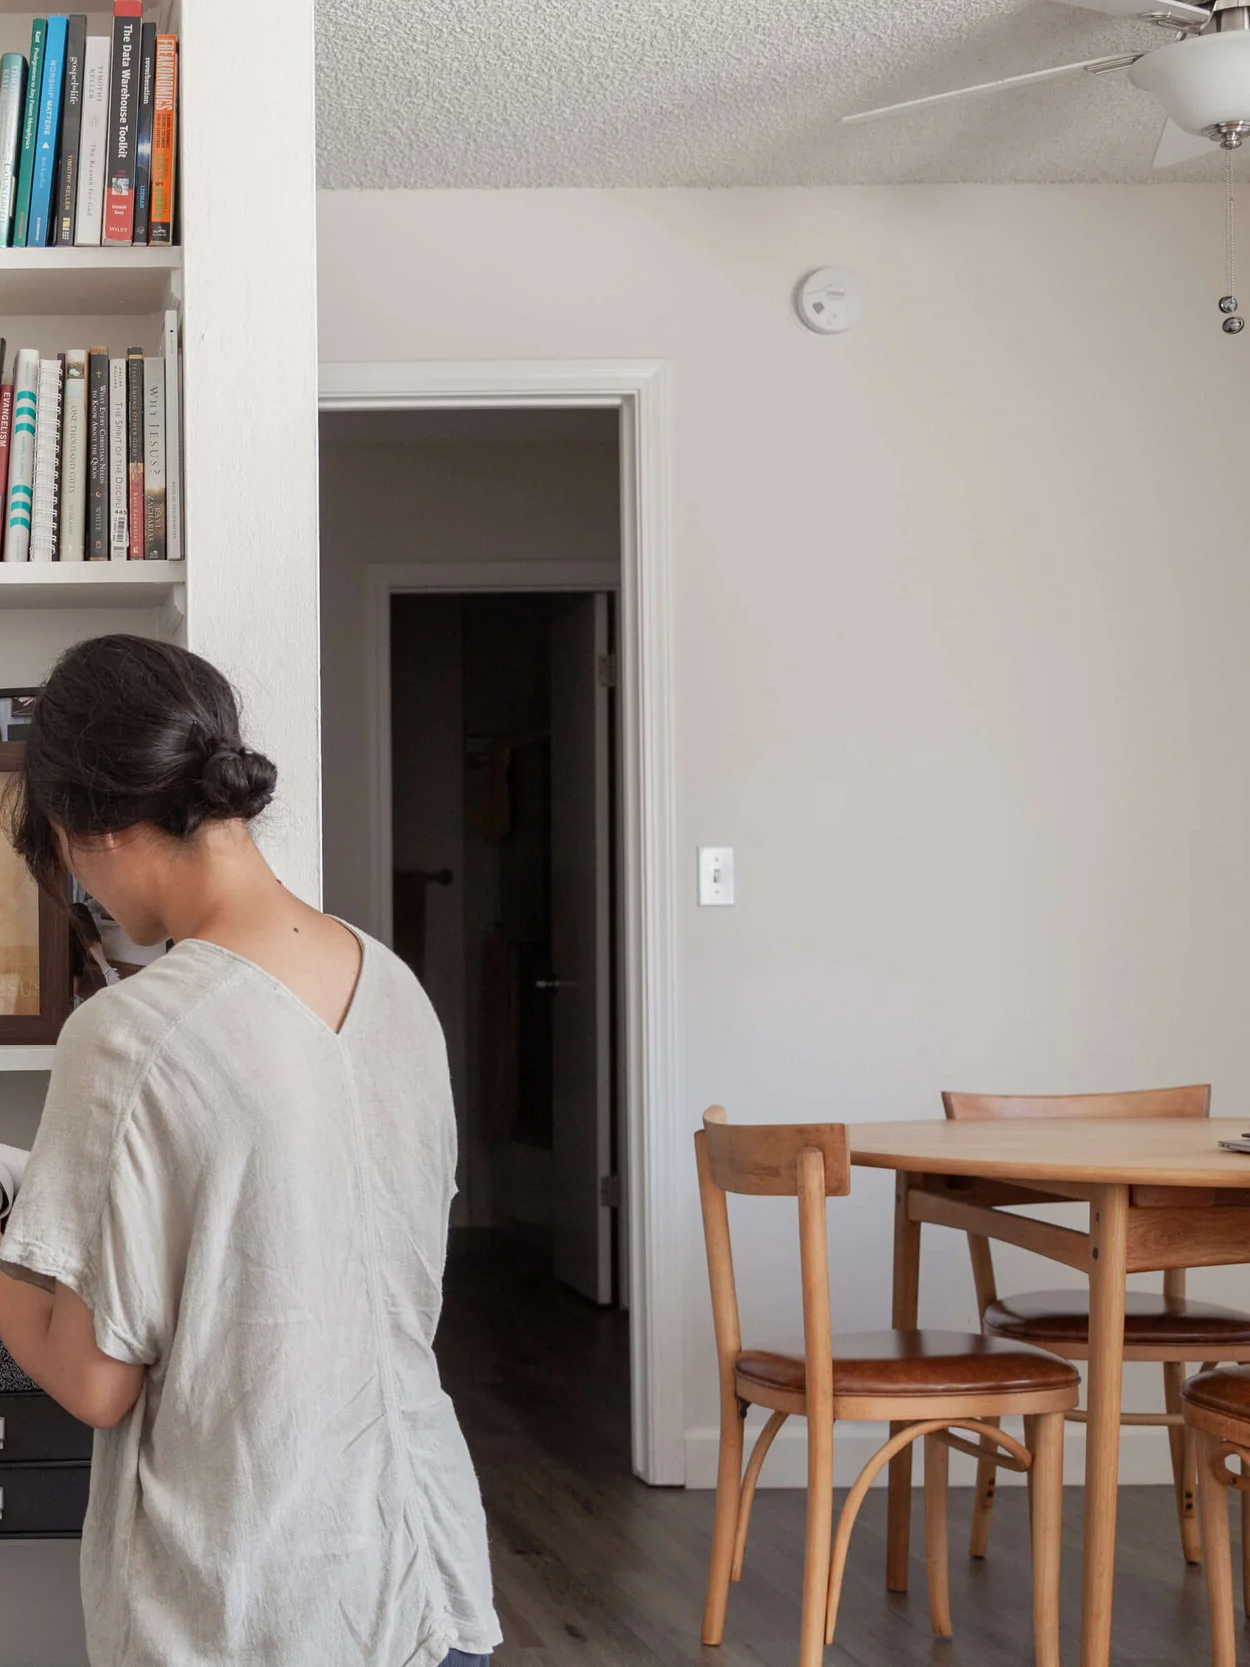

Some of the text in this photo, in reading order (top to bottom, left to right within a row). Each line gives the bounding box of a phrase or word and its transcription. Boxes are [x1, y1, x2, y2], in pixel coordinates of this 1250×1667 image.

[34, 31, 42, 43] Kant
[88, 69, 96, 100] KELLER
[96, 65, 104, 103] TIMOTHY
[142, 57, 152, 105] reverberation
[155, 38, 175, 111] FREAKONOMICS
[44, 60, 57, 135] WORSHIP MATTERS
[117, 24, 133, 159] The Data Warehouse Toolkit
[63, 155, 73, 210] TIMOTHY KELLER
[87, 160, 96, 186] Reason
[86, 201, 94, 217] God
[87, 188, 95, 199] for
[92, 390, 98, 398] TO
[92, 400, 100, 419] KNOW
[91, 421, 100, 443] ABOUT
[98, 385, 107, 484] WHAT EVERY CHRISTIAN NEEDS
[147, 385, 161, 475] WHY JESUS?
[68, 405, 78, 494] ONE THOUSAND GIFTS
[91, 444, 99, 456] THE
[94, 506, 103, 532] WHITE
[147, 495, 156, 542] ZACHARIAS
[154, 507, 162, 529] RAVI
